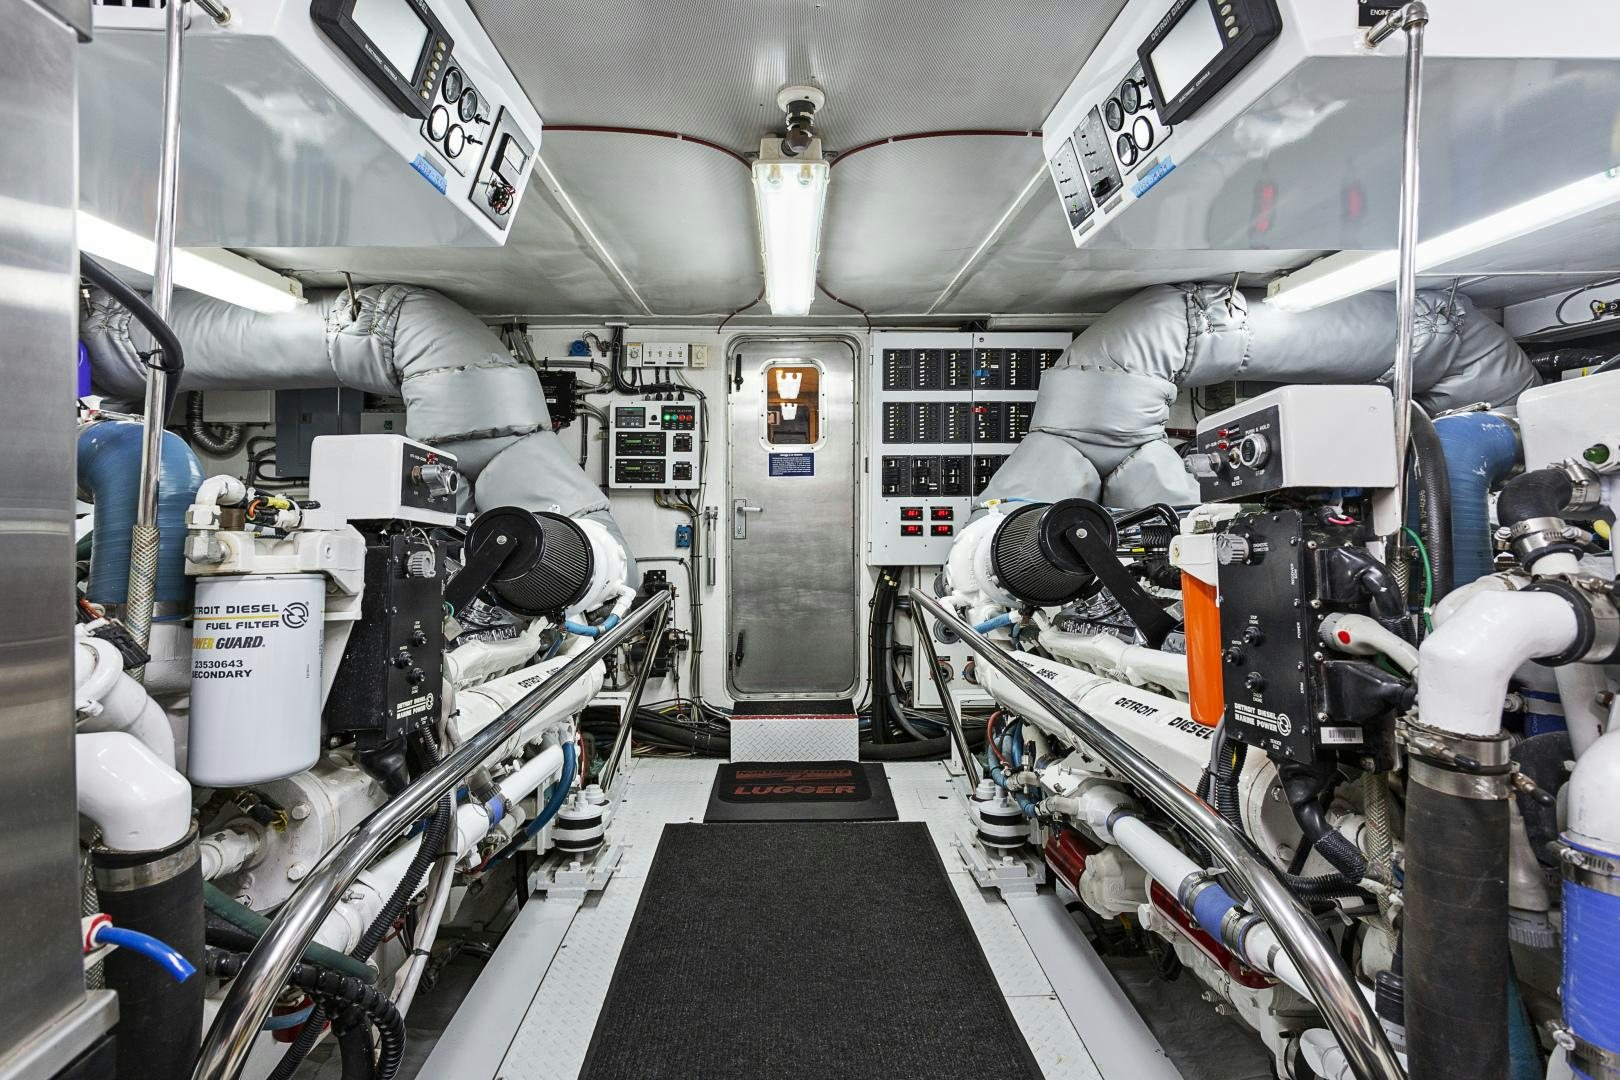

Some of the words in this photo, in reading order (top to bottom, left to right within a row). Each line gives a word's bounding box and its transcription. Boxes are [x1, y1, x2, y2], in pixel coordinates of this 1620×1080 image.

[1150, 12, 1172, 41] DETROIT
[1171, 0, 1188, 16] DIES
[226, 603, 279, 614] DIESEL
[206, 622, 232, 631] FUEL
[236, 620, 279, 630] FILTER
[194, 659, 244, 669] 23530643
[1114, 697, 1159, 717] DETROIT
[1167, 716, 1216, 740] DIESEL
[1234, 702, 1257, 715] DETROIT
[1257, 708, 1278, 721] DIESEL
[1234, 713, 1256, 726] MARINE
[1256, 719, 1279, 733] POWER
[734, 785, 856, 795] LUGGER
